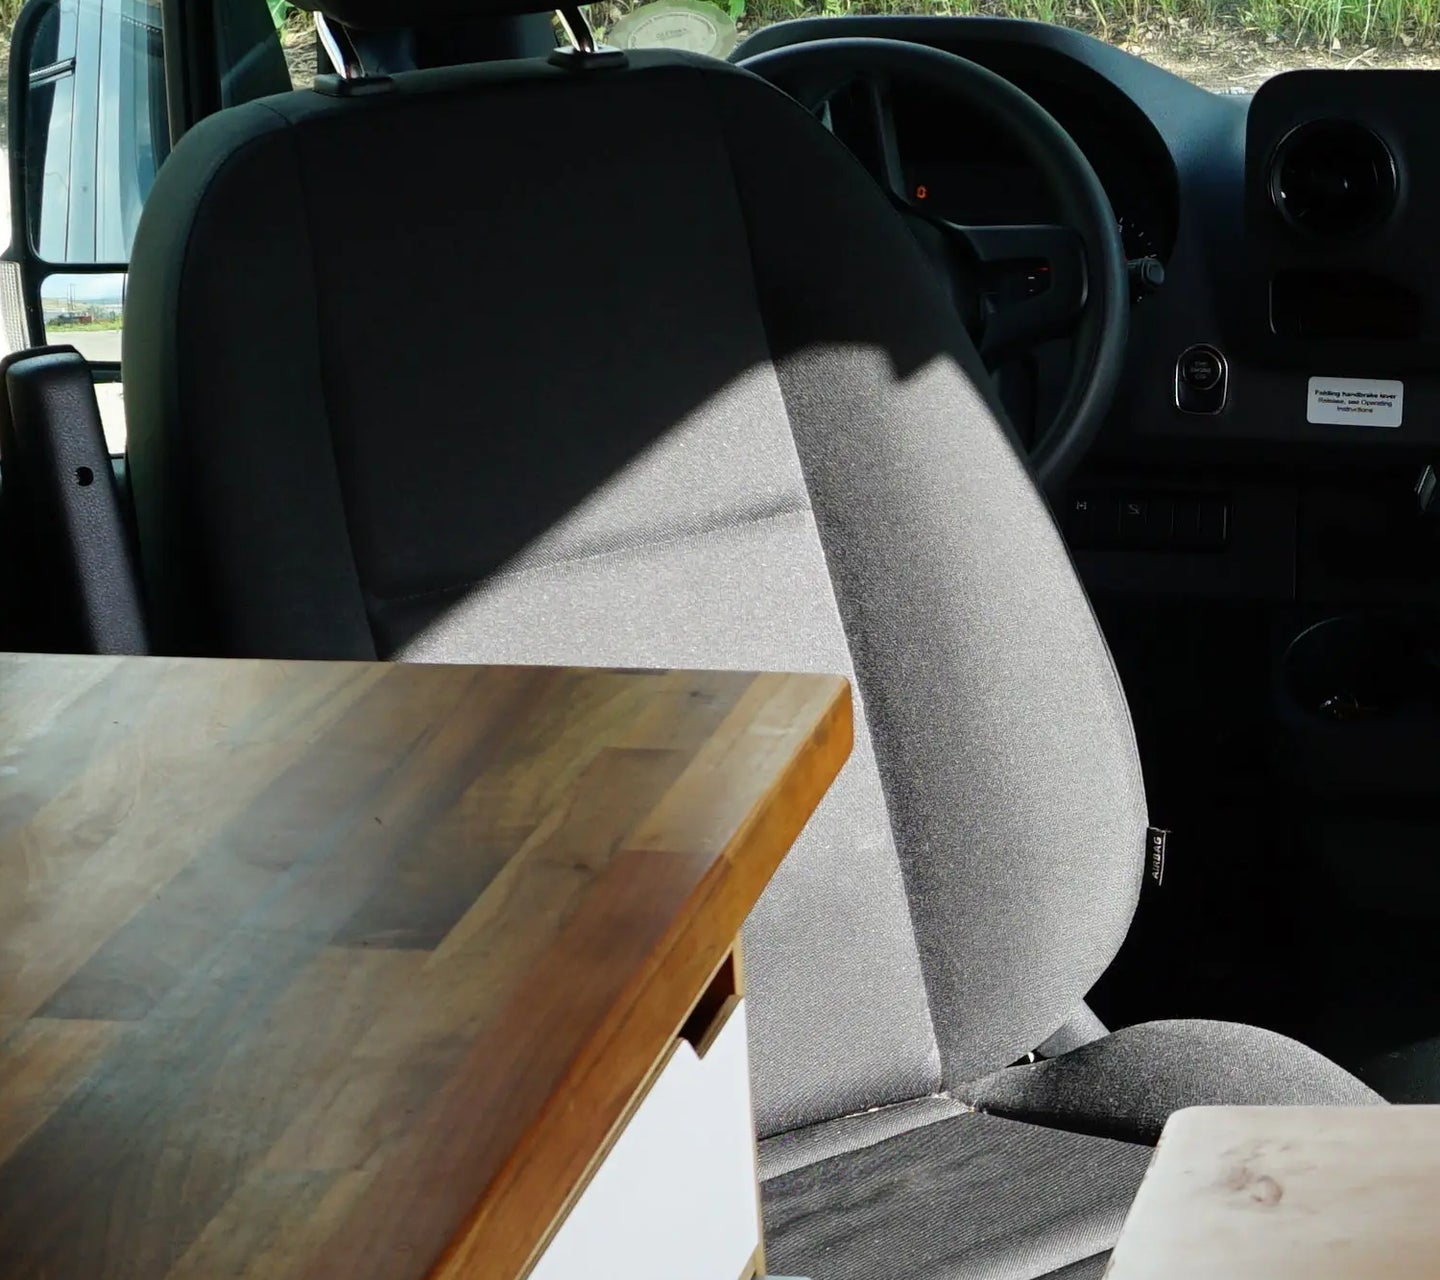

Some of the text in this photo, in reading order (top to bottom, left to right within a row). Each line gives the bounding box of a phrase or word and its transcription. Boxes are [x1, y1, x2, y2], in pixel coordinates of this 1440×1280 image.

[1315, 389, 1340, 399] Folding
[1341, 391, 1377, 400] handbrake
[1361, 400, 1392, 409] Operating
[1337, 405, 1373, 415] Instructions
[1152, 835, 1162, 880] AIRBAG
